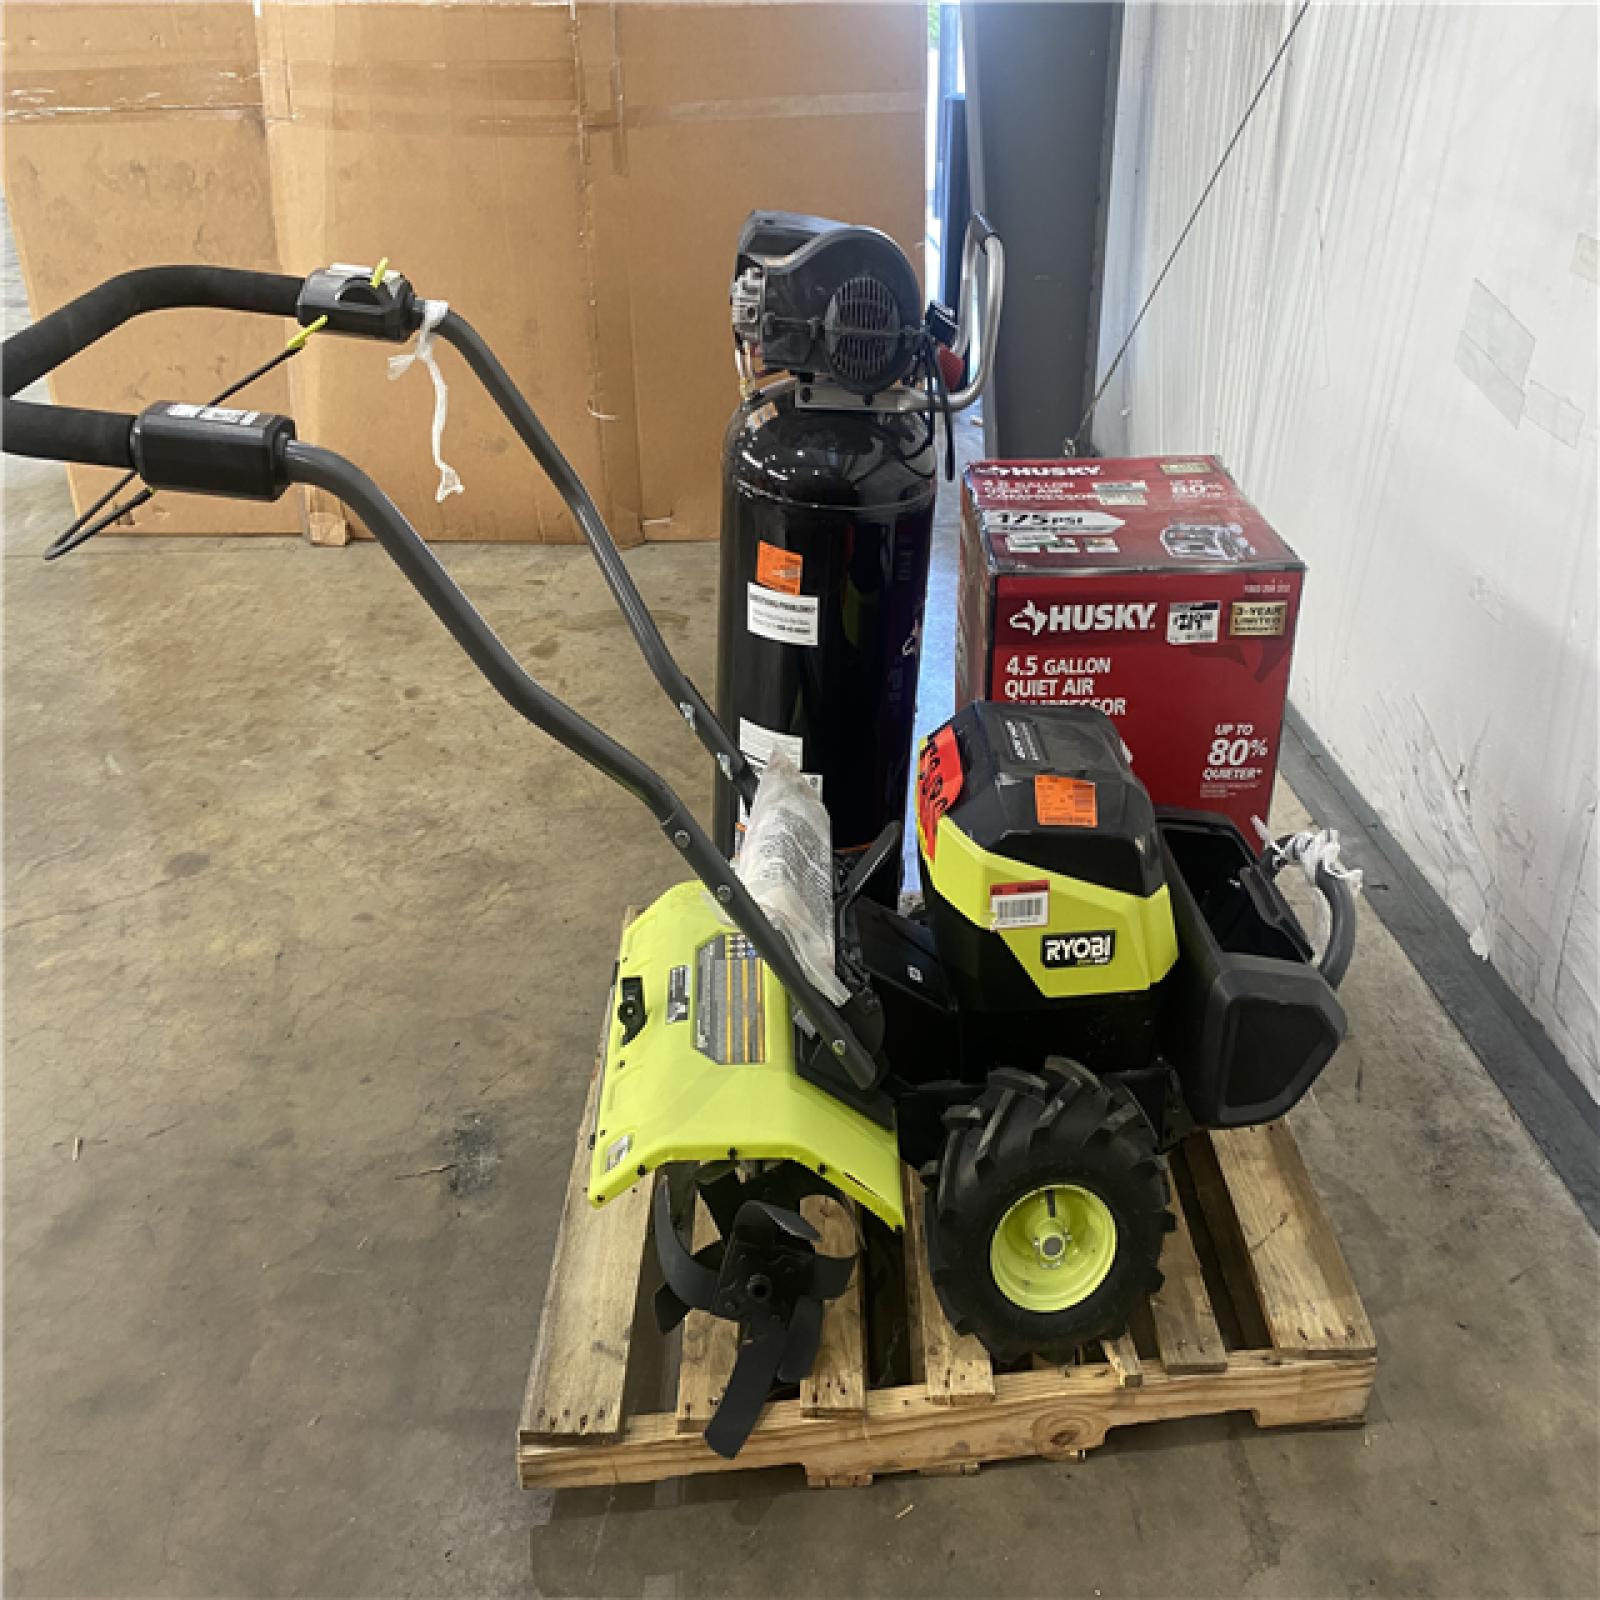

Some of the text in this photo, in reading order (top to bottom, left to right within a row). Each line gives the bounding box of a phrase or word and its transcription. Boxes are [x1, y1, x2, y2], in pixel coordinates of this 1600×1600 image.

[1011, 466, 1101, 476] HUSKY
[1049, 603, 1157, 631] HUSKY
[1006, 655, 1111, 675] 4.5 GALLON
[1005, 677, 1095, 699] QUIET AIR
[1215, 724, 1253, 735] UP TO
[1207, 738, 1268, 766] 80%
[1045, 935, 1110, 961] RYOBI
